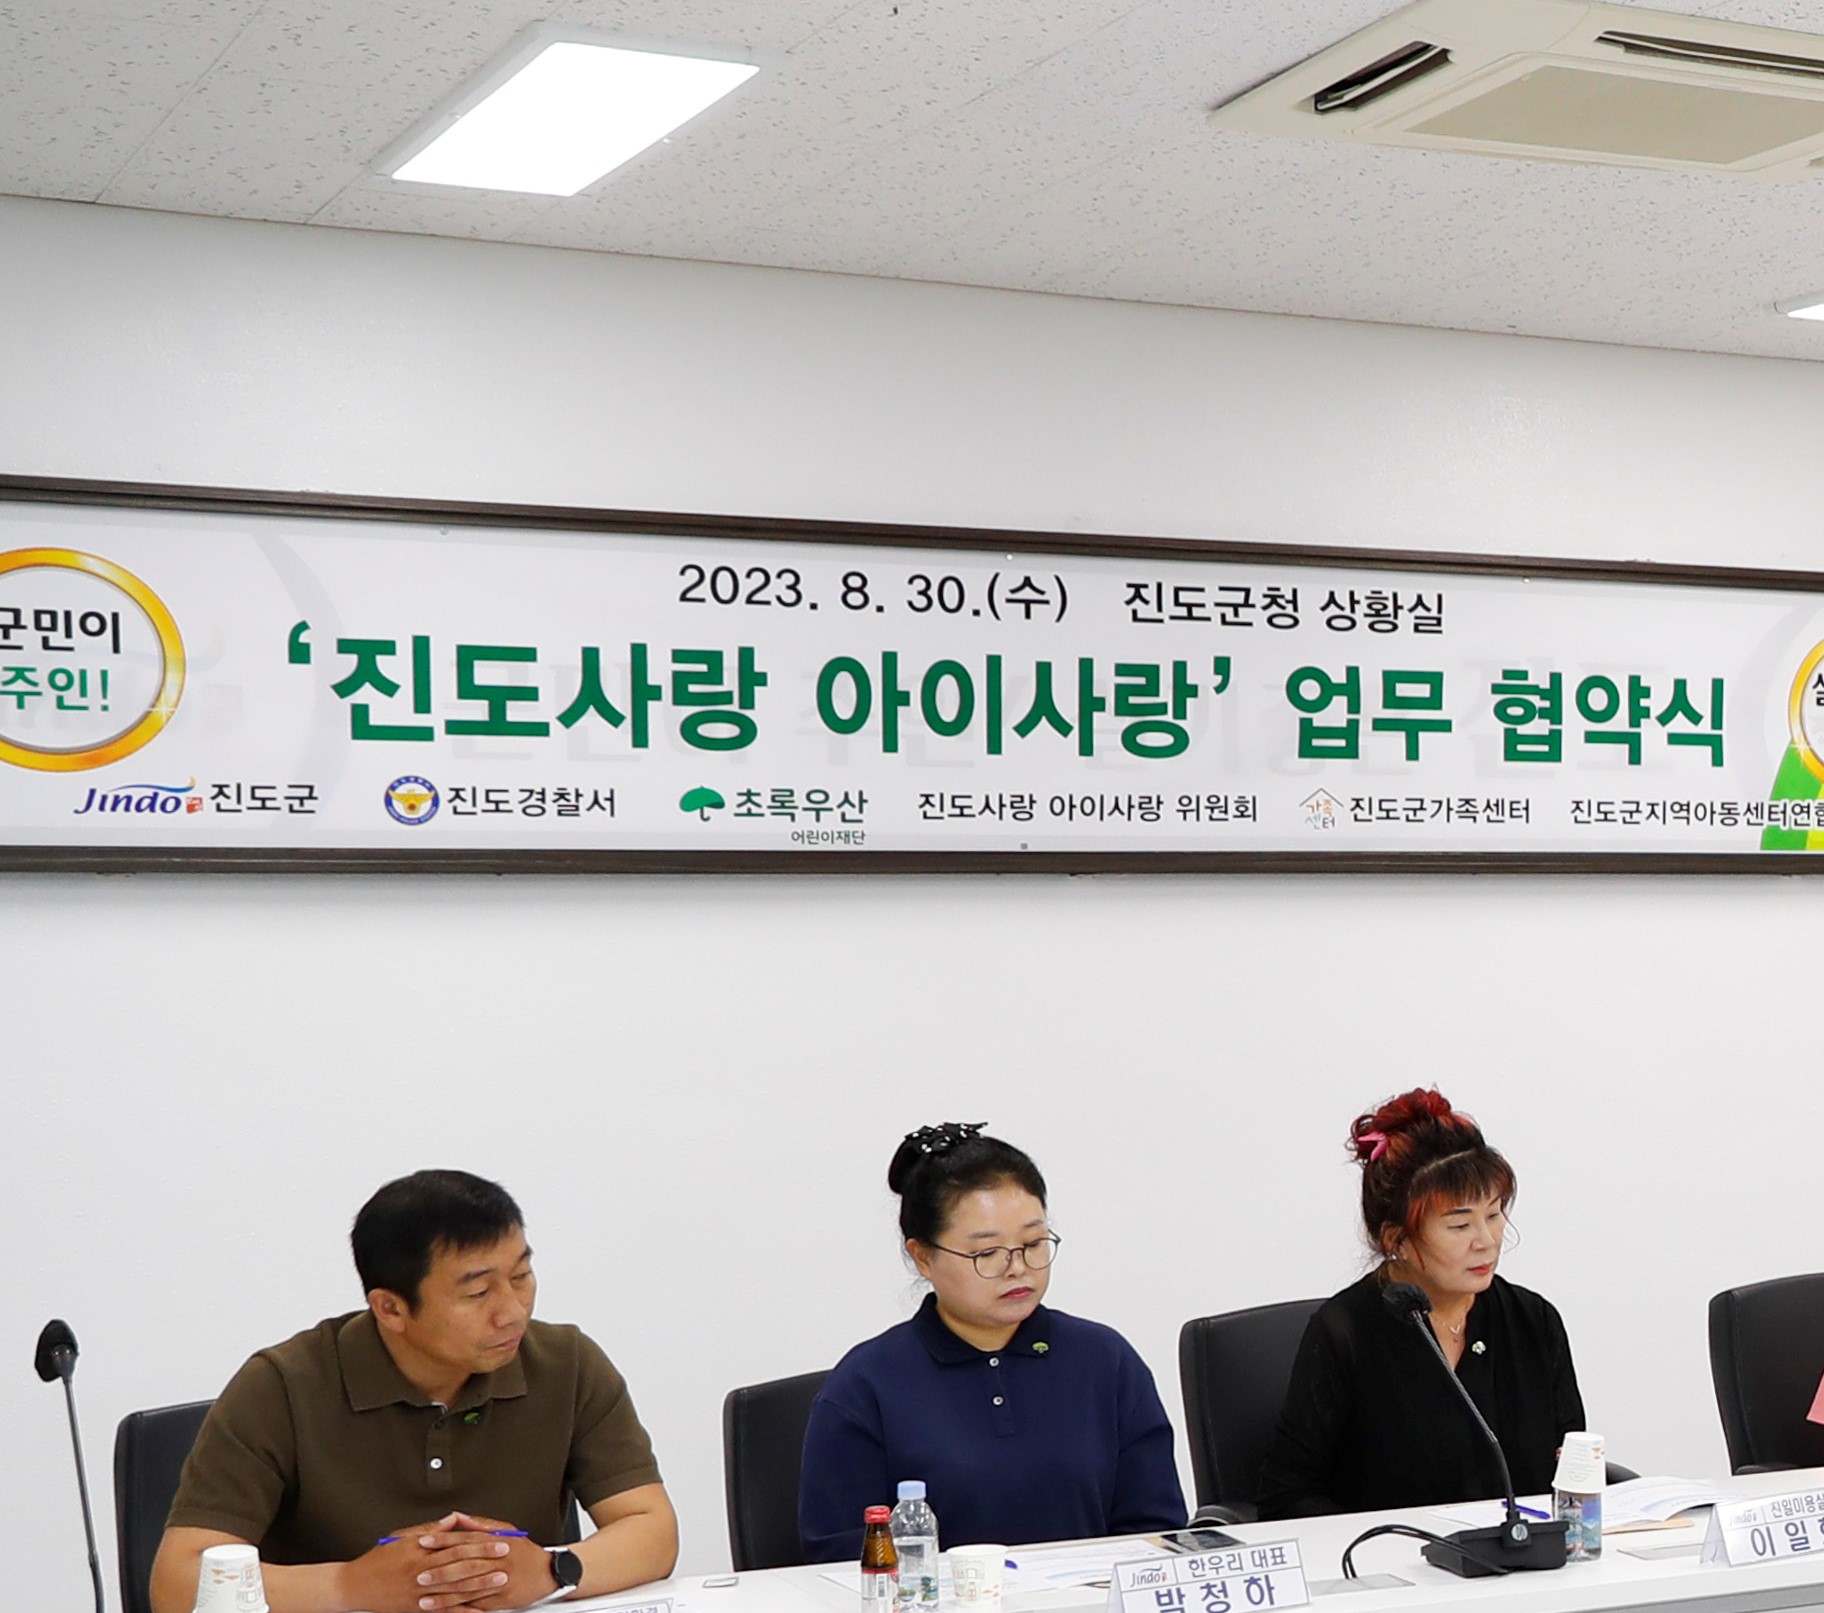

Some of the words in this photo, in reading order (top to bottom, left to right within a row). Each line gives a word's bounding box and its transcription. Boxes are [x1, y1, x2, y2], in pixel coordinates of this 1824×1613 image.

[679, 562, 820, 611] 2023.
[841, 570, 886, 614] 8.
[906, 573, 1070, 624] 30.(수)
[1123, 579, 1303, 632] 진도군청
[1318, 588, 1447, 636] 상황실
[0, 607, 121, 654] 군민이
[0, 667, 110, 712] 주인!
[1283, 664, 1454, 763] 업무
[1490, 666, 1727, 770] 협약식
[209, 782, 319, 817] 진도군
[445, 785, 617, 819] 진도경찰서
[732, 788, 868, 823] 초록우산
[917, 790, 1037, 822] 진도사랑
[1049, 793, 1165, 823] 아이사랑
[1174, 793, 1259, 824] 위원회
[1349, 796, 1532, 826] 진도군가족센터
[790, 828, 867, 846] 어린이재단
[1188, 1552, 1244, 1578] 한우리
[1251, 1546, 1288, 1569] 대표
